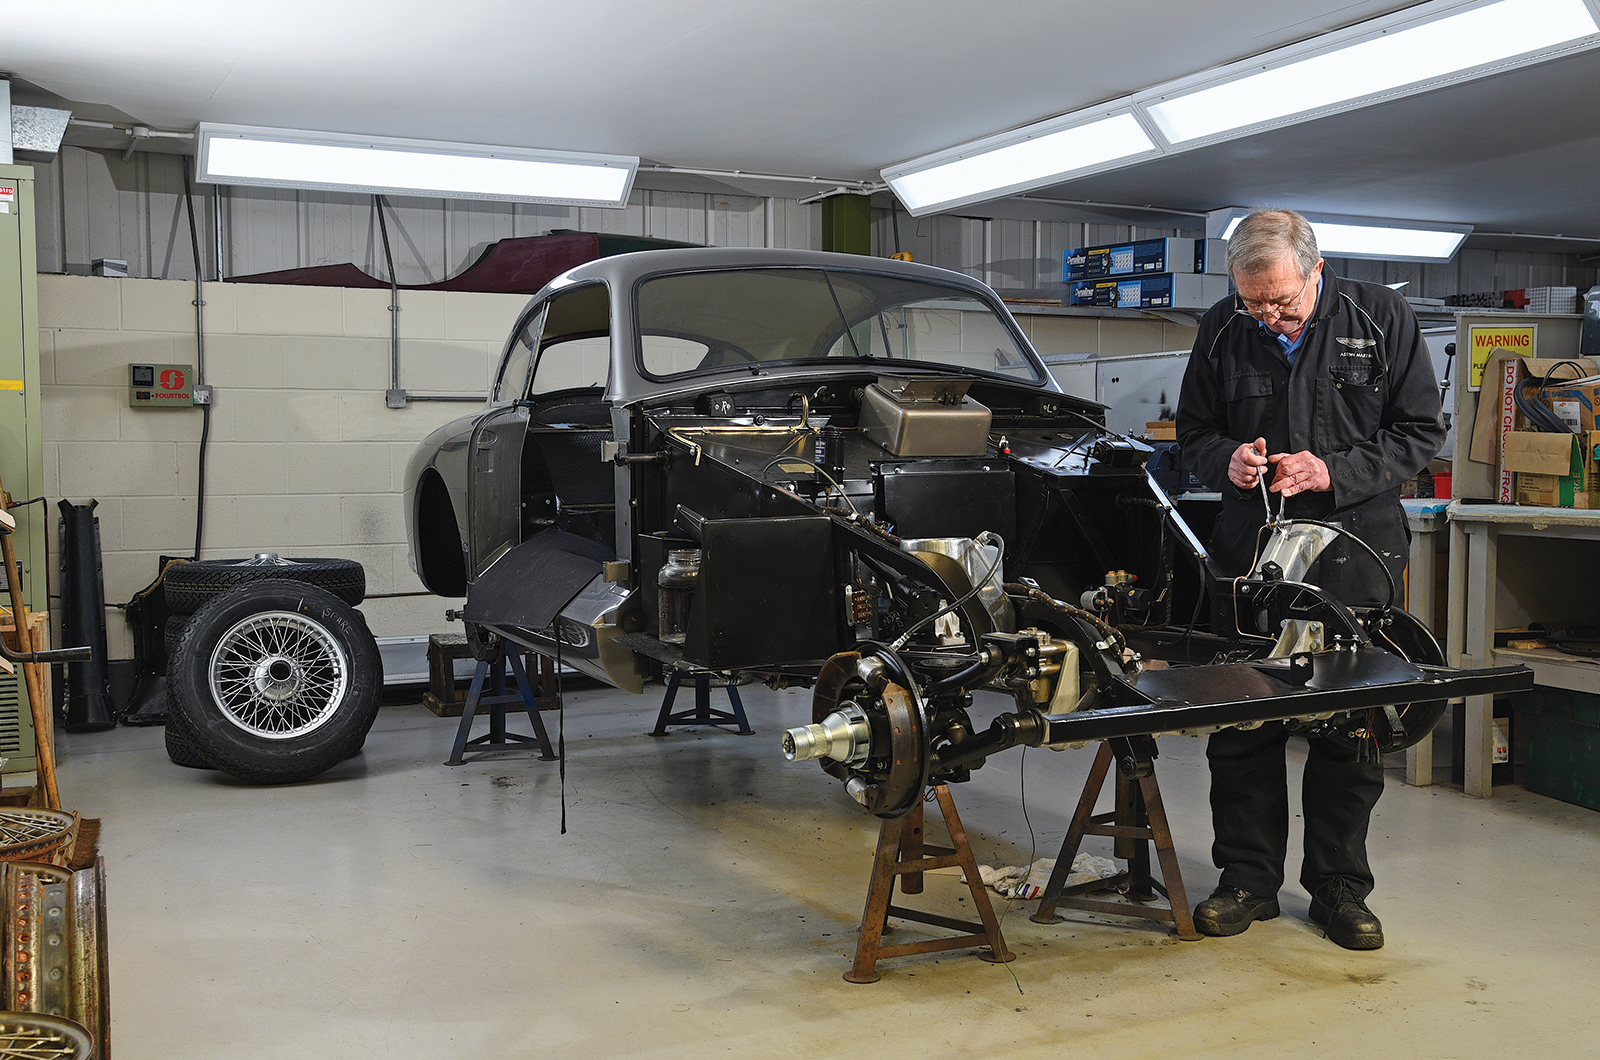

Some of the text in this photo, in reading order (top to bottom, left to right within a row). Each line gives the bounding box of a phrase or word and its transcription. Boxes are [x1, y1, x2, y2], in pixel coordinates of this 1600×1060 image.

[1475, 334, 1529, 347] WARNING
[1506, 366, 1514, 384] DO
[1504, 387, 1513, 413] NOT
[322, 607, 353, 635] SPARE
